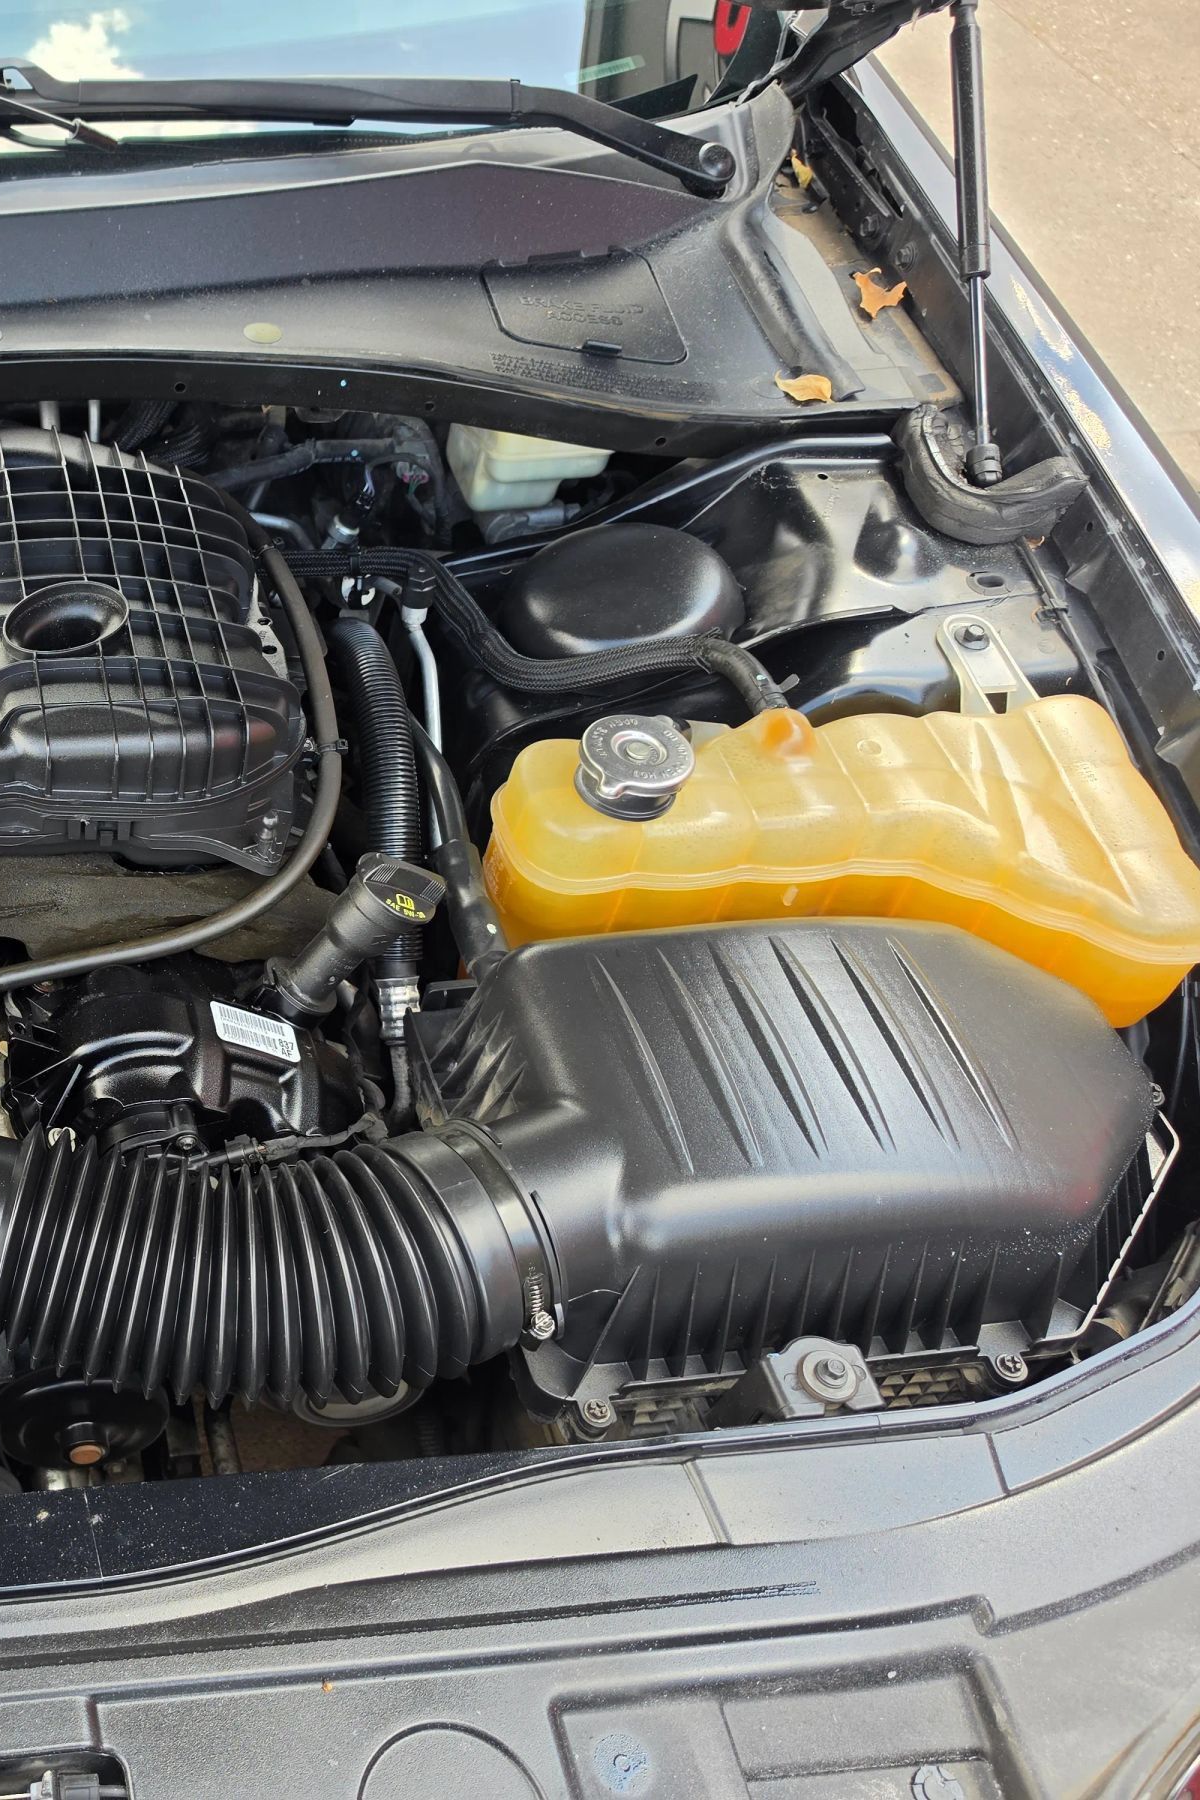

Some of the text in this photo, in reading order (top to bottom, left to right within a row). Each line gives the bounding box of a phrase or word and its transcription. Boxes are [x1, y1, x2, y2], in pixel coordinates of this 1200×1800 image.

[519, 296, 644, 315] BRAKE FLUID
[547, 312, 624, 326] ACCESS
[385, 898, 401, 912] SAE
[278, 1038, 294, 1051] 837
